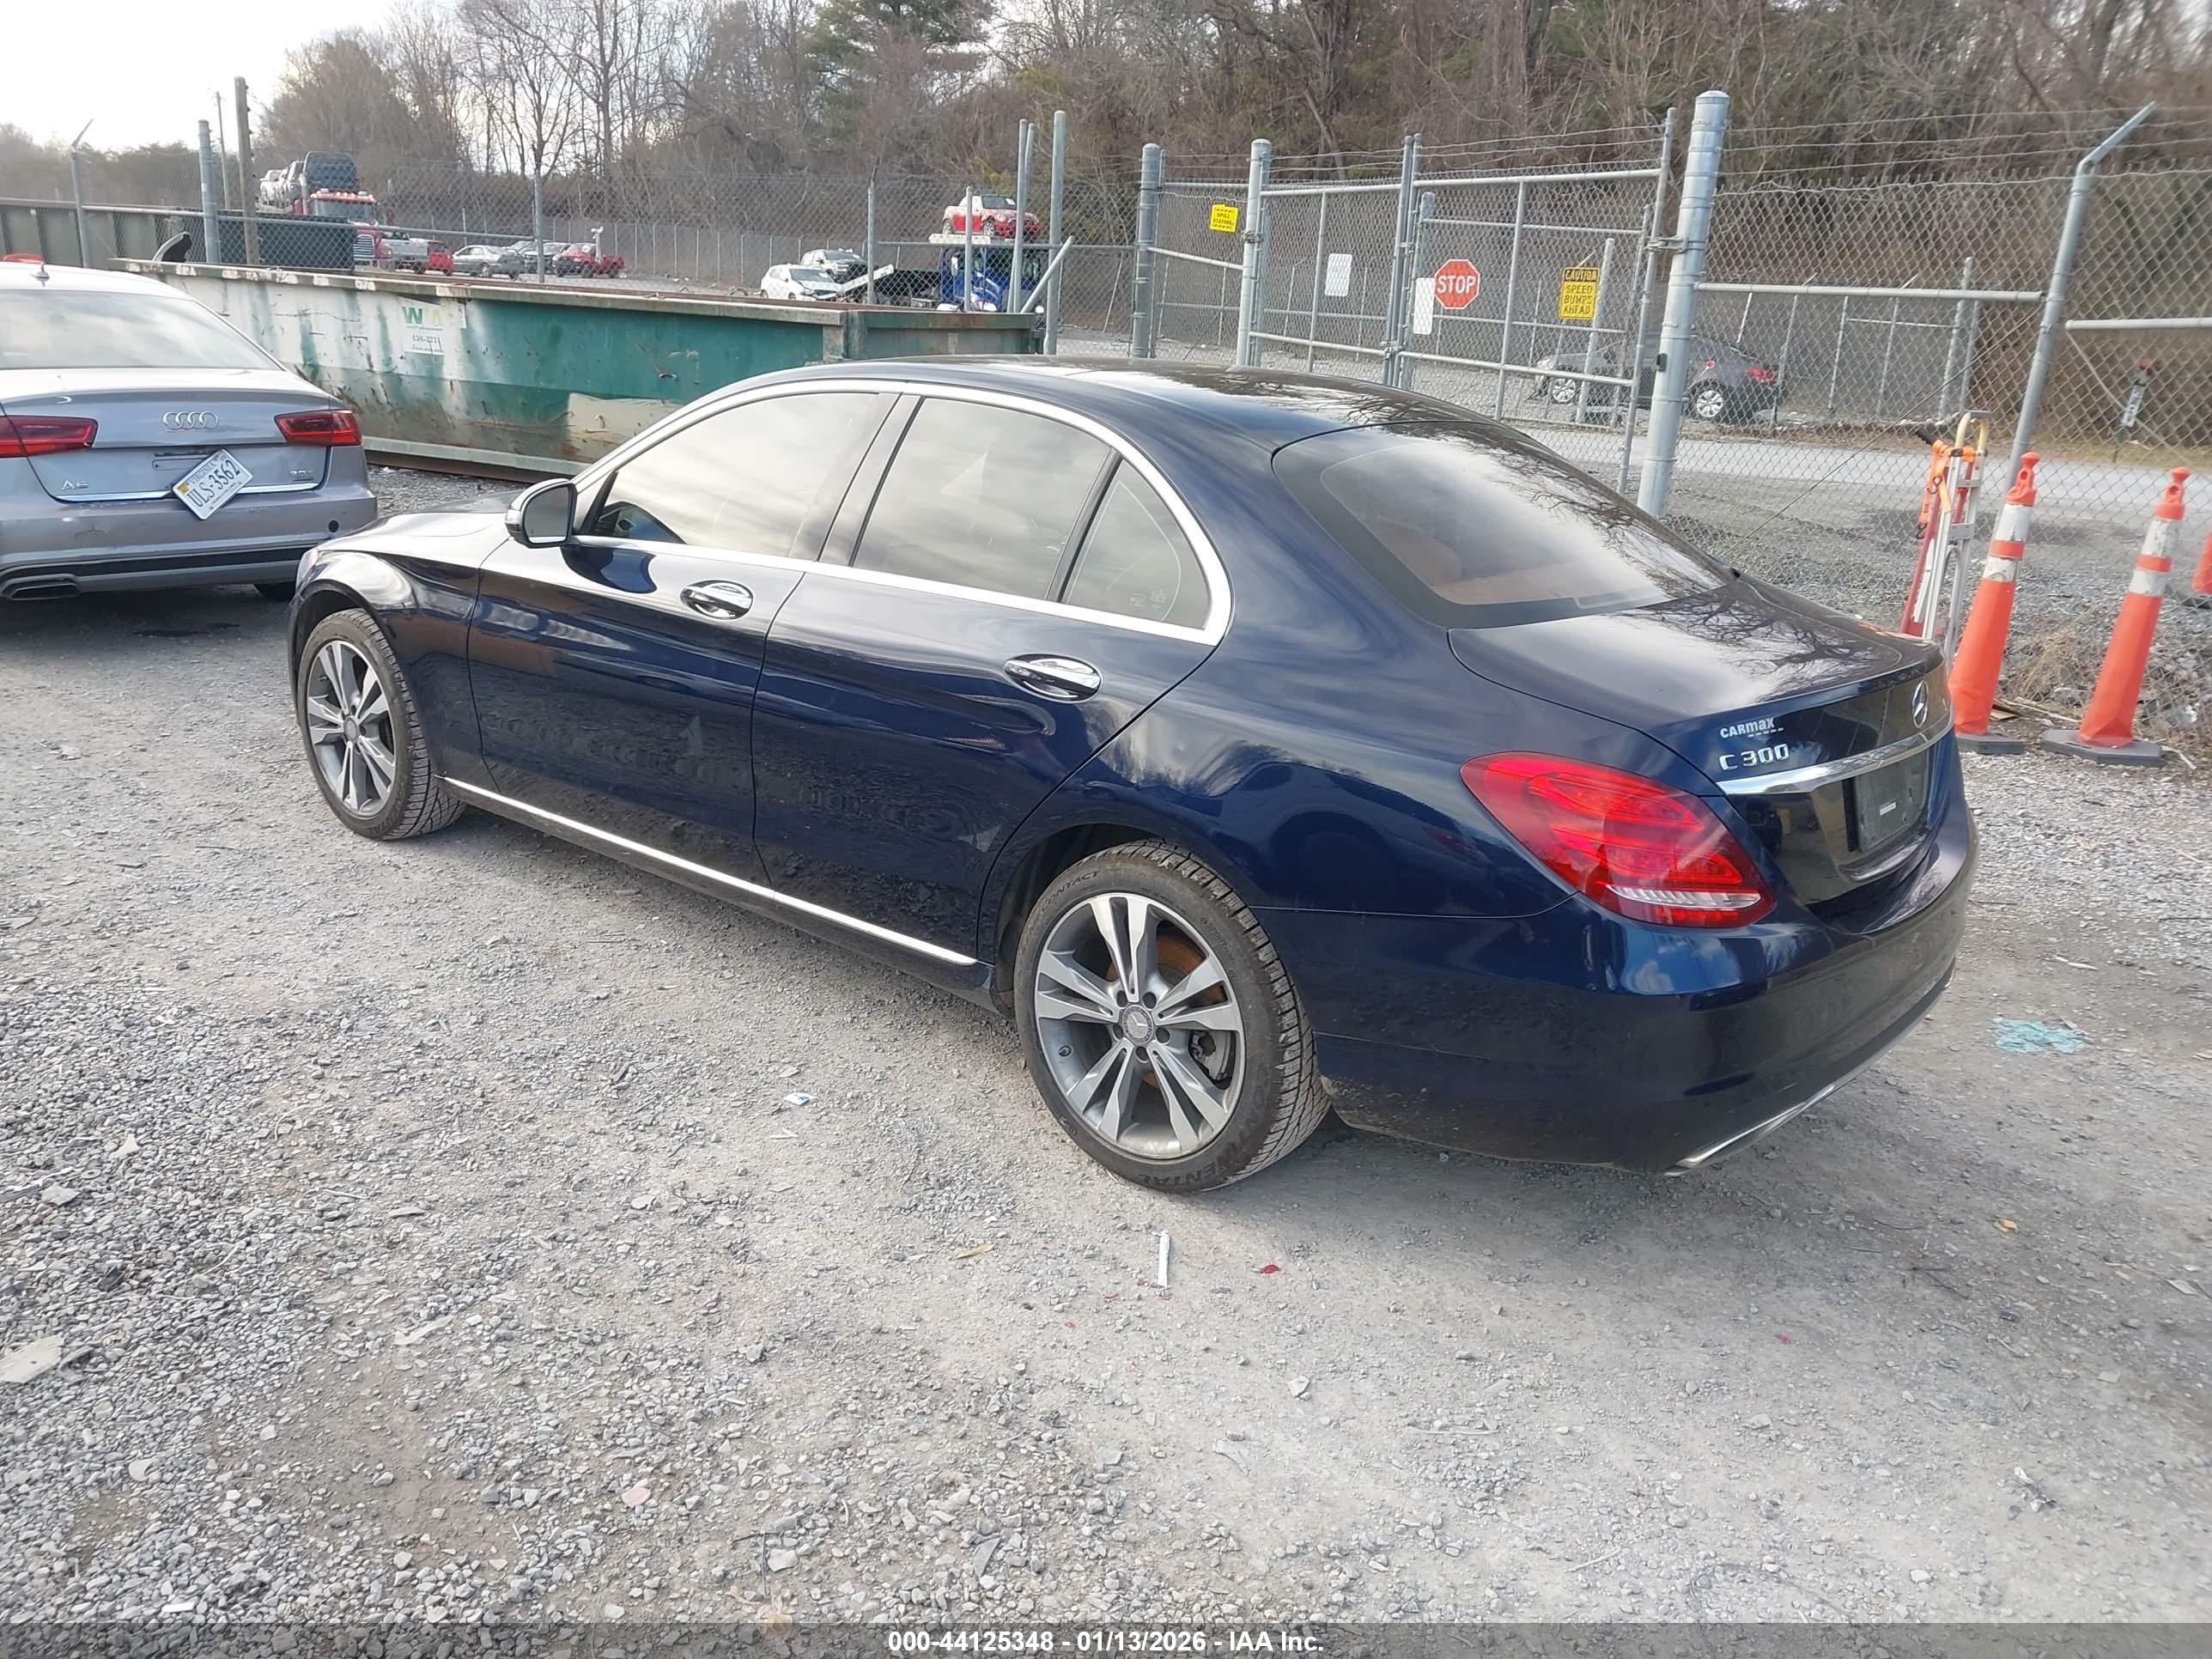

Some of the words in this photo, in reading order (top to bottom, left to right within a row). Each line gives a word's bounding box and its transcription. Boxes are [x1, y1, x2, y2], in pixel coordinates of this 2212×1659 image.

[1565, 269, 1597, 281] CAUTION
[1437, 275, 1476, 294] STOP
[1565, 284, 1592, 294] SPEED
[1564, 295, 1593, 304] BUMPS
[1563, 305, 1591, 314] AHEAD
[1719, 754, 1738, 770] C
[1741, 743, 1790, 767] 300
